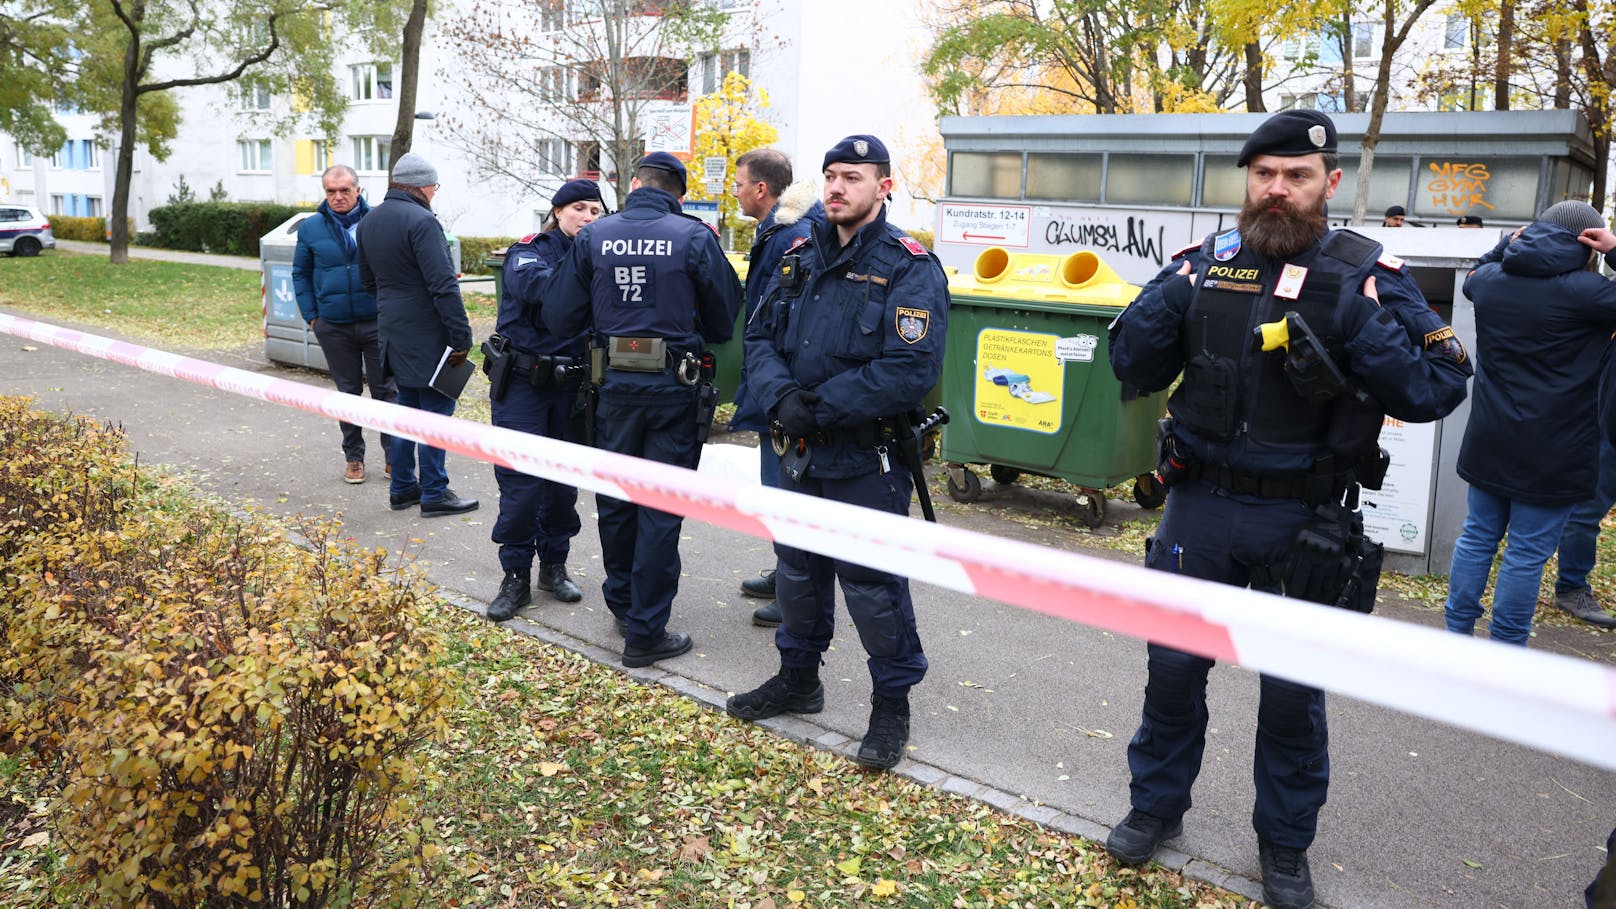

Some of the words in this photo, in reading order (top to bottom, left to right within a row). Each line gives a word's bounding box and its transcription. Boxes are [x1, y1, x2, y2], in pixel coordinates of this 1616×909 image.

[1429, 162, 1491, 180] MFG
[946, 208, 997, 219] Kundratstr.
[1000, 210, 1025, 220] 12-14
[1045, 220, 1120, 252] CLUMSY
[601, 239, 672, 256] POLIZEI
[614, 266, 646, 285] BE
[1208, 266, 1259, 281] POLIZEI
[619, 284, 643, 302] 72
[899, 309, 927, 319] POLIZEI
[984, 335, 1048, 347] PLASTIKFLASCHEN
[982, 352, 1007, 361] DOSEN
[983, 344, 1053, 357] GETRÄNKEKARTONS
